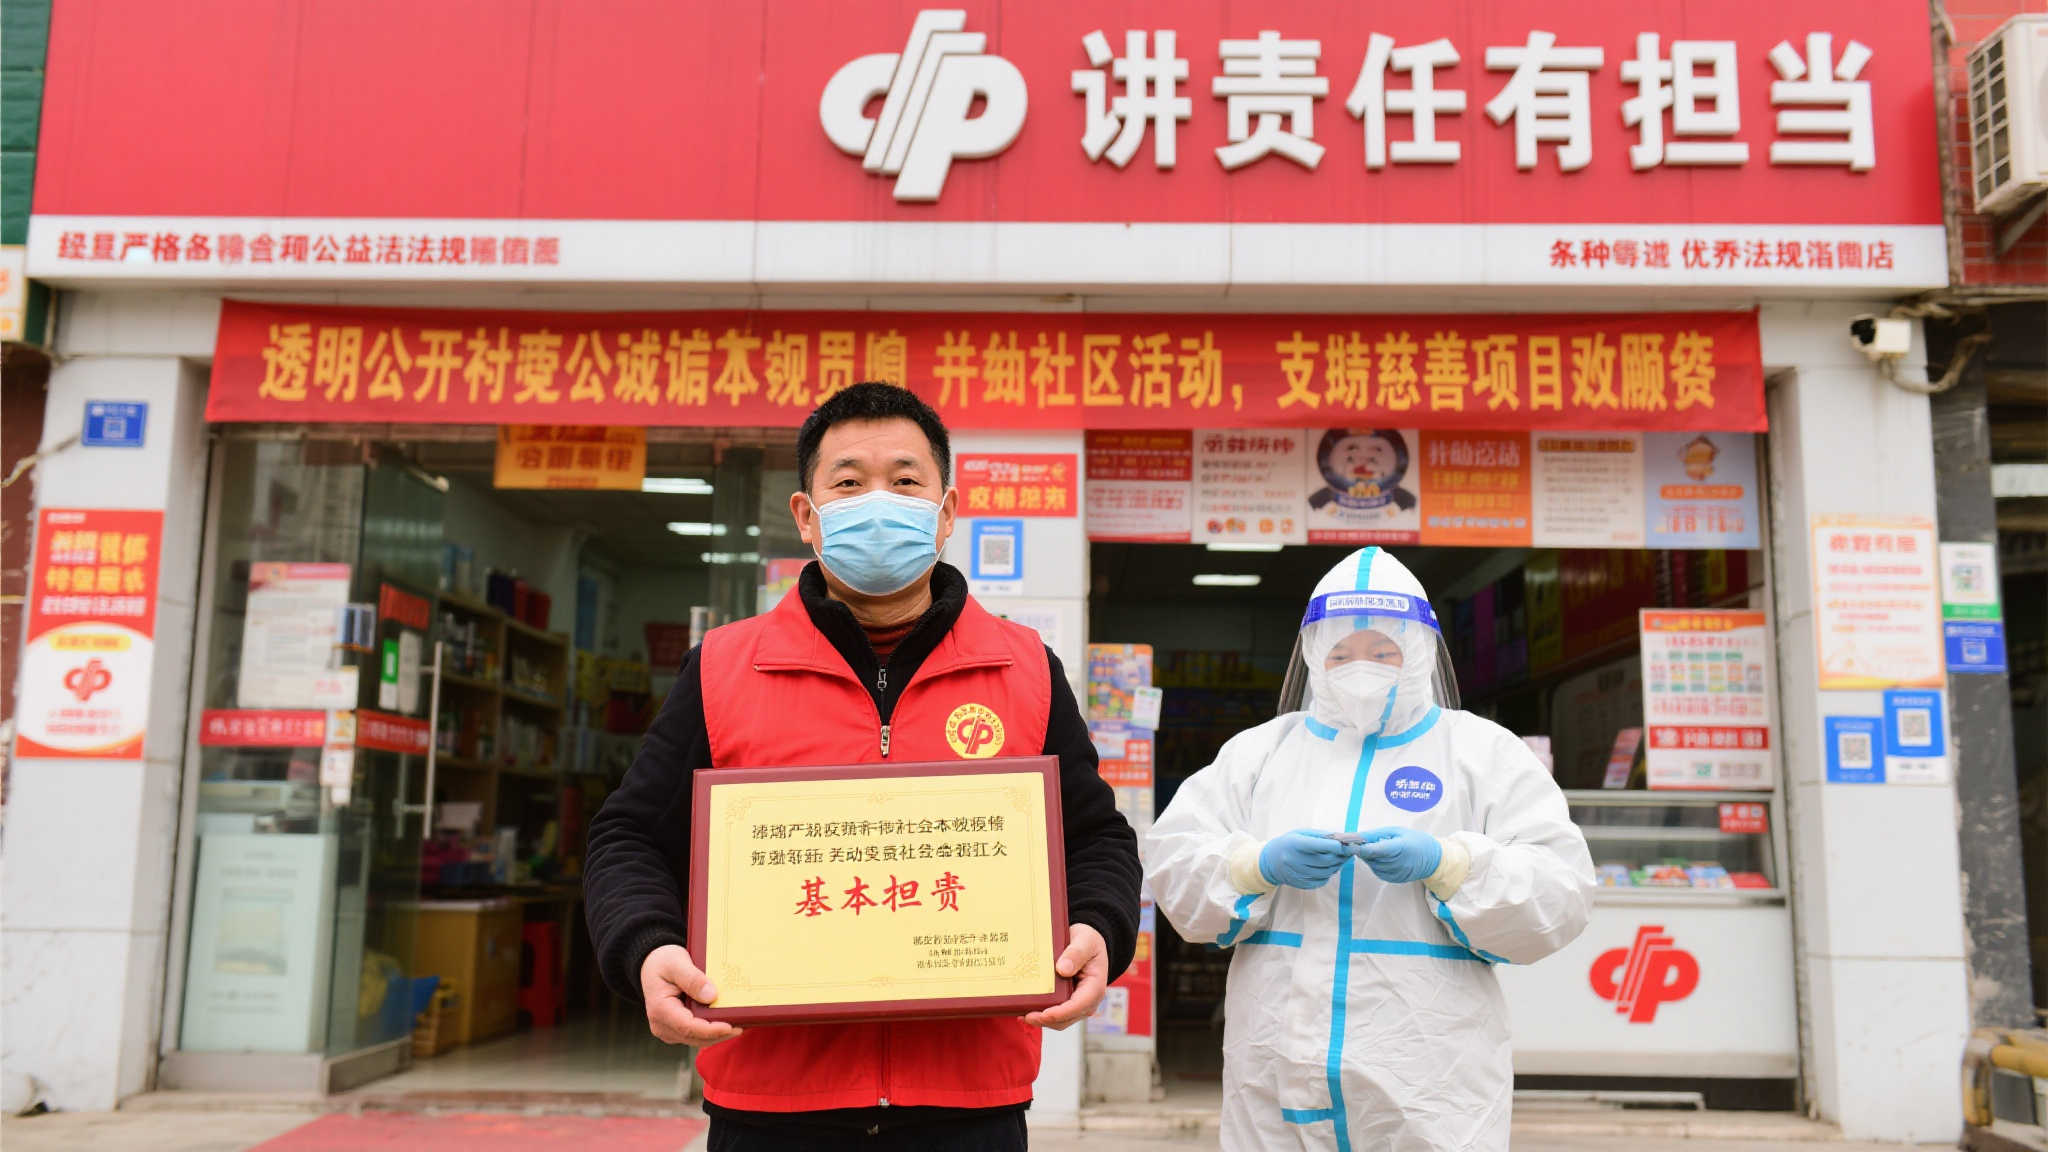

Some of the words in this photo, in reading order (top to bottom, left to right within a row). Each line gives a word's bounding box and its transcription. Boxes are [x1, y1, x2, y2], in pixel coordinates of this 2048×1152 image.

[1071, 29, 1876, 170] 讲责任有担当
